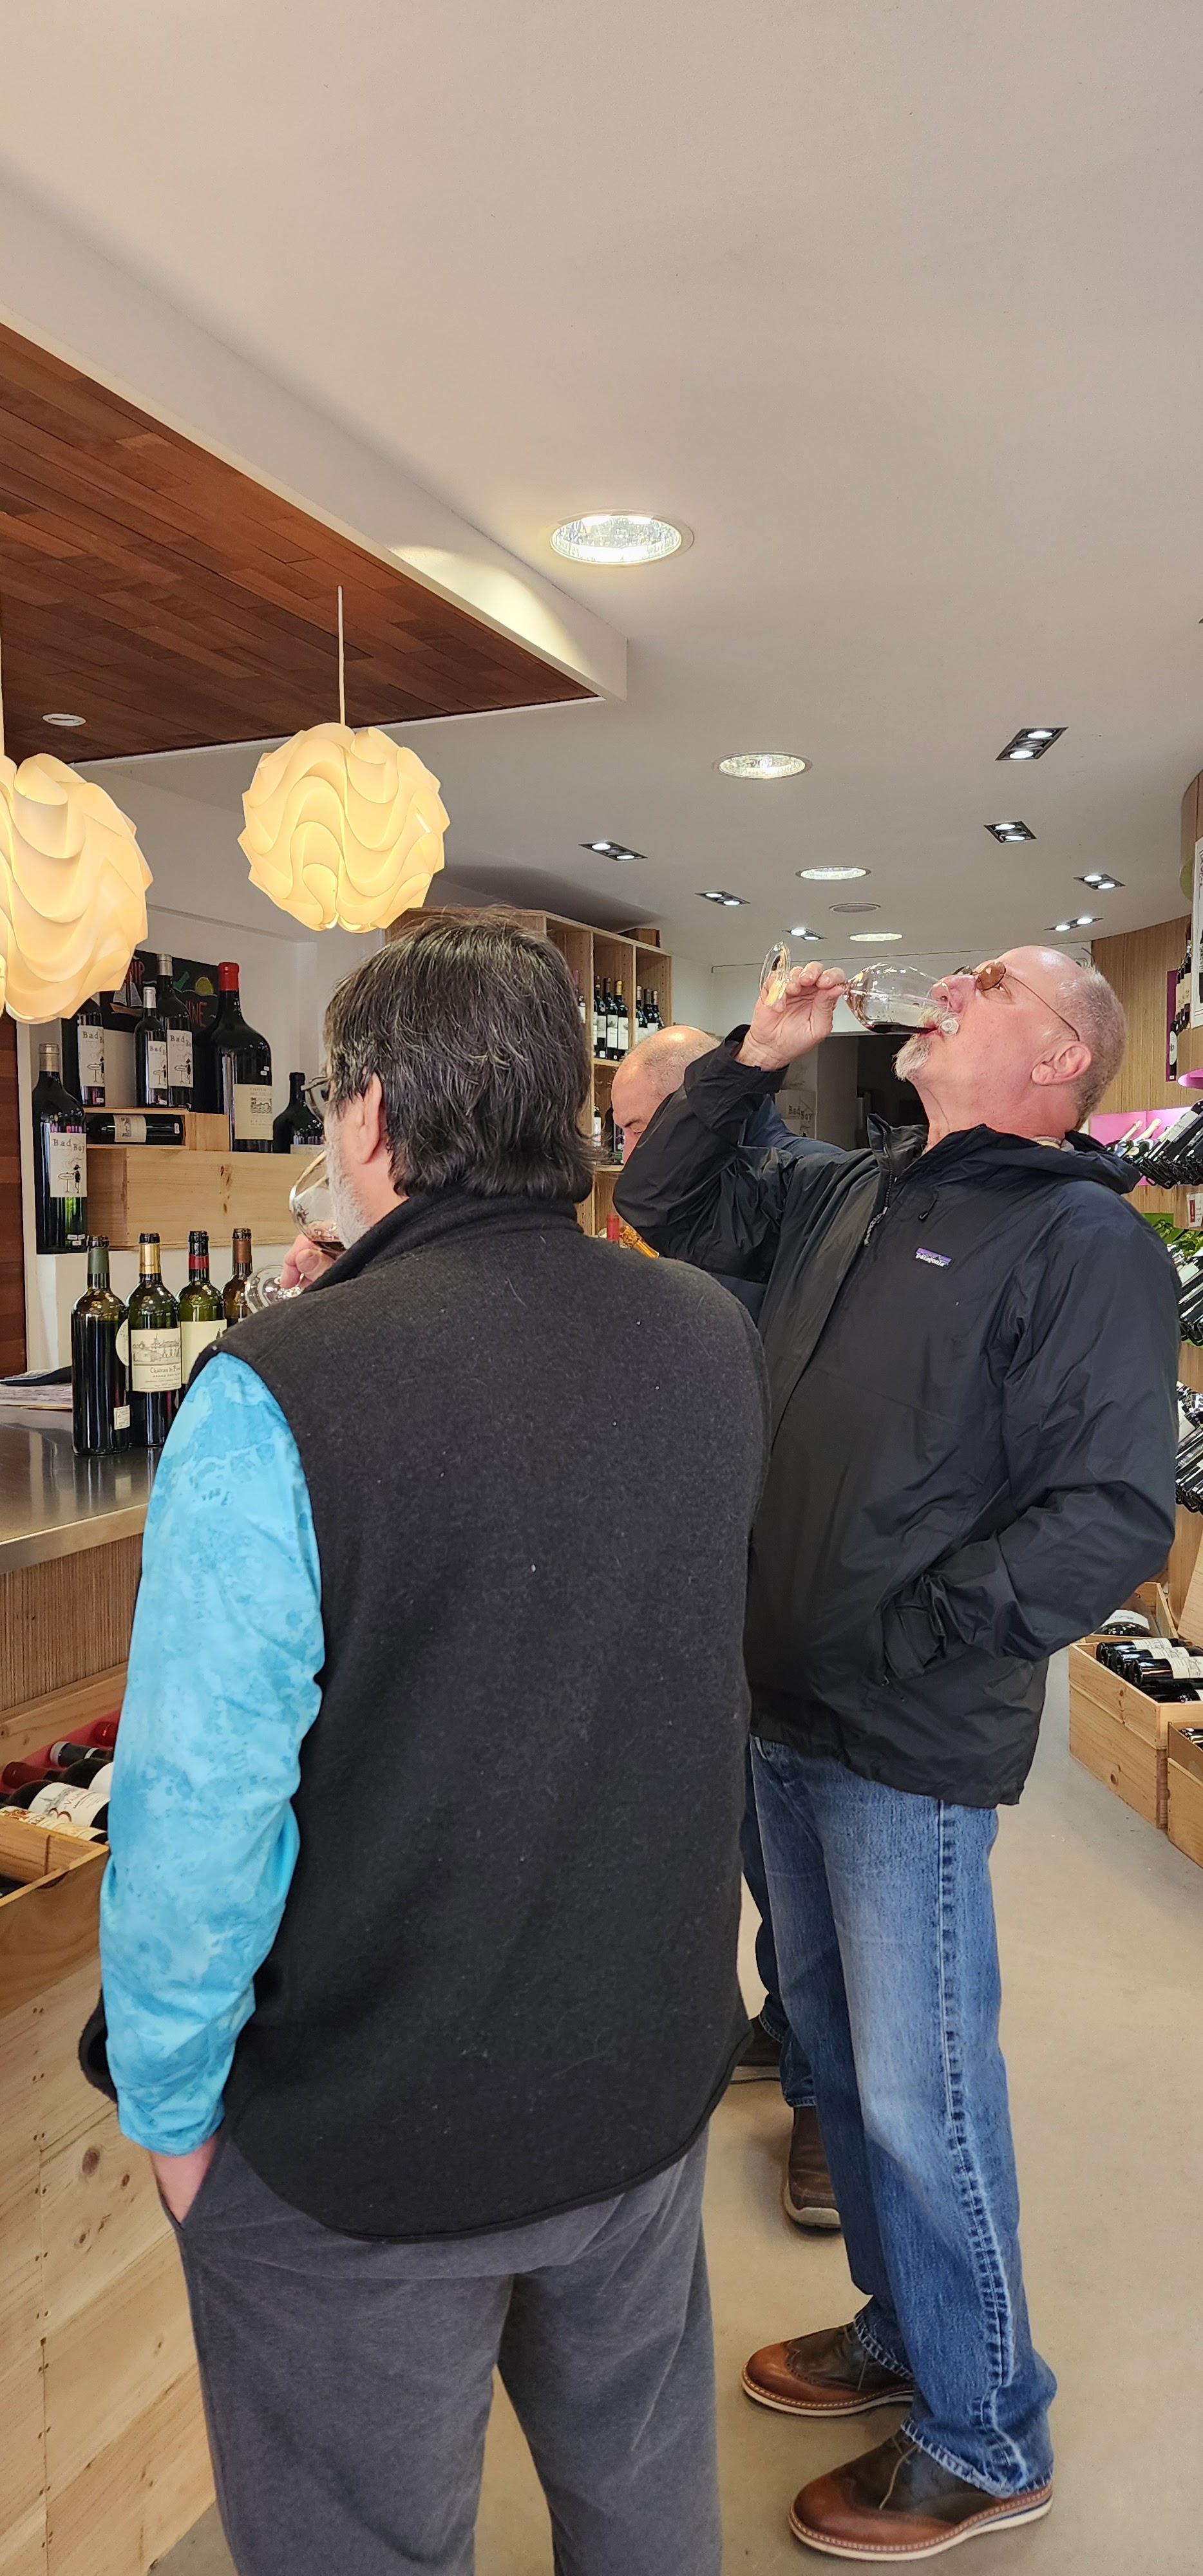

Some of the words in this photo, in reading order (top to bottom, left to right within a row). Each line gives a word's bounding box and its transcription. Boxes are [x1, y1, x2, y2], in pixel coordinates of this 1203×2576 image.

[82, 1031, 99, 1039] Bad
[53, 1139, 72, 1147] Bad
[915, 1253, 945, 1267] patagonia
